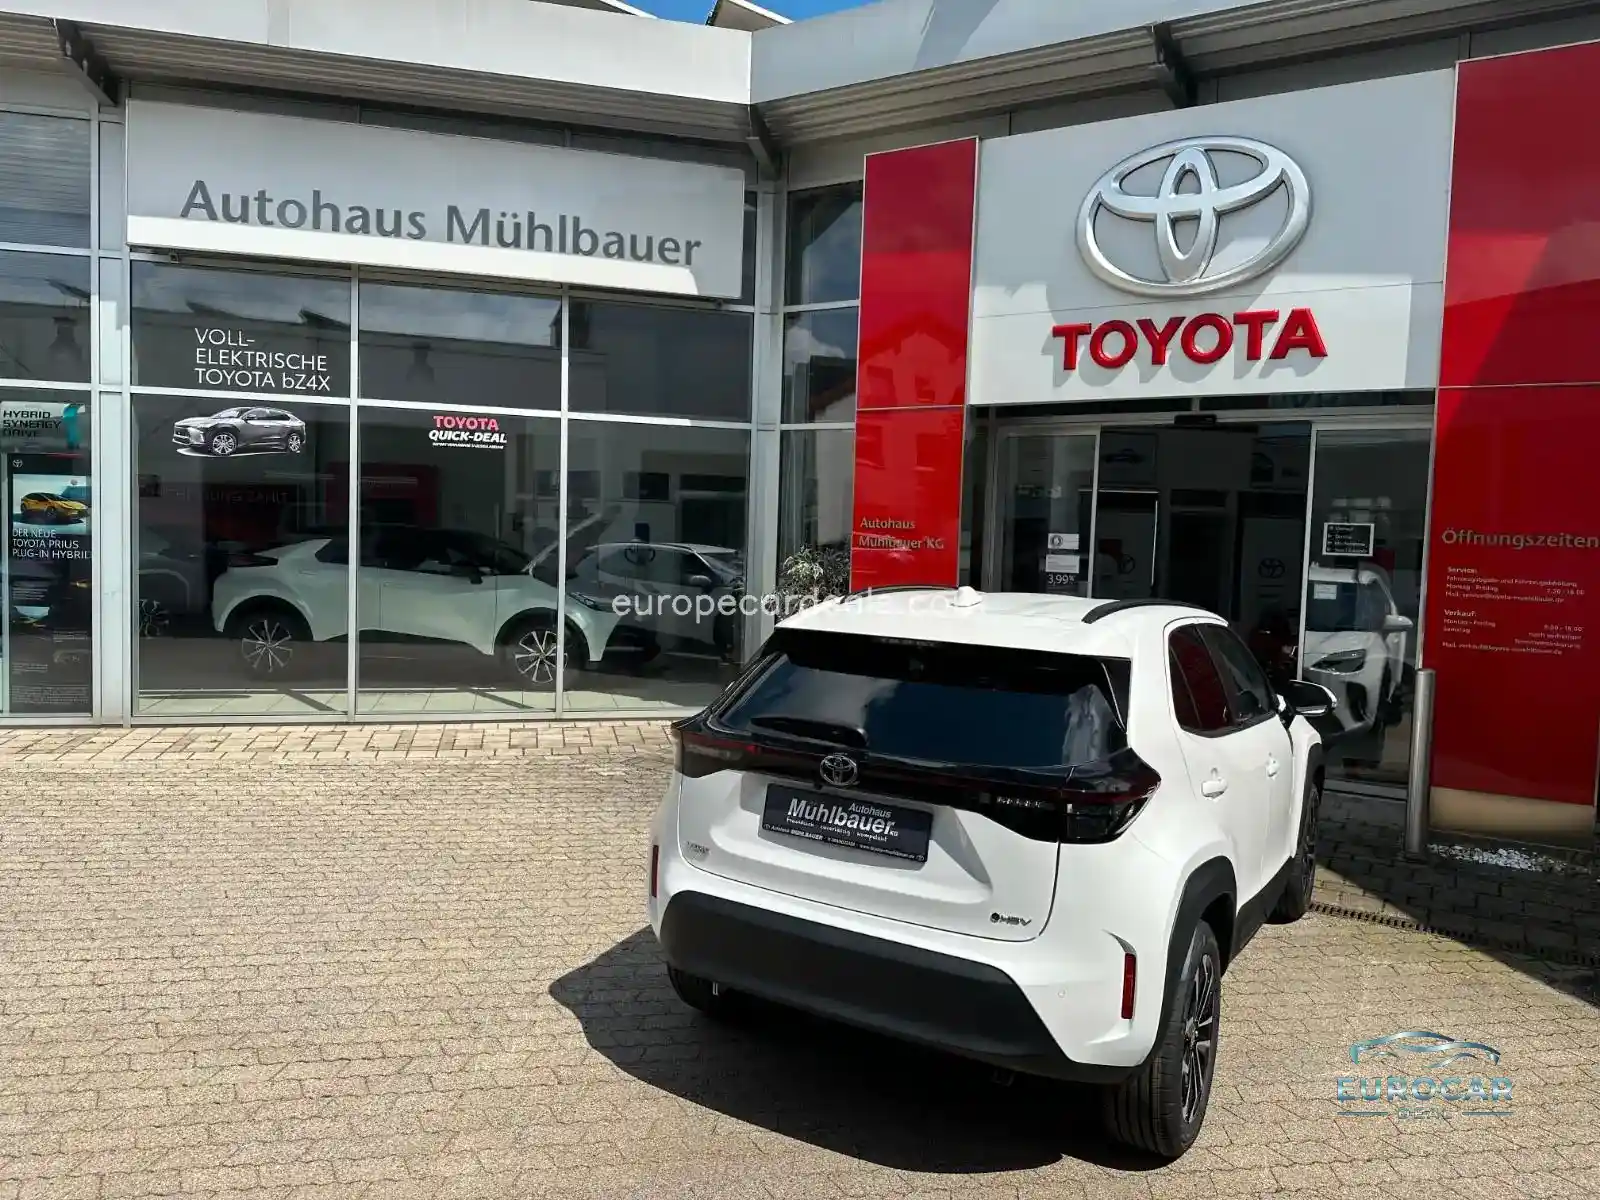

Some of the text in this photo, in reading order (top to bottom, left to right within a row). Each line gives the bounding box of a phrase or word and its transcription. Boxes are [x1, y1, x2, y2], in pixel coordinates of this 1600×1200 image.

[179, 179, 703, 267] Autohaus Mühlbauer
[194, 327, 256, 347] VOLL-
[1052, 307, 1328, 371] TOYOTA
[196, 347, 328, 372] ELEKTRISCHE
[194, 367, 331, 392] TOYOTA bZ4X
[3, 410, 51, 419] HYBRID
[3, 419, 62, 429] SYNERGY
[433, 415, 499, 431] TOYOTA
[428, 429, 508, 444] QUICK-DEAL
[860, 516, 917, 529] Autohaus
[12, 528, 57, 539] DER NEUE
[1441, 527, 1599, 550] Öffnungszeiten
[12, 538, 80, 549] TOYOTA PRIUS
[926, 536, 944, 550] KG
[12, 548, 49, 558] PLUG-IN
[787, 797, 896, 835] Mühlbauer
[848, 802, 892, 818] Autohaus
